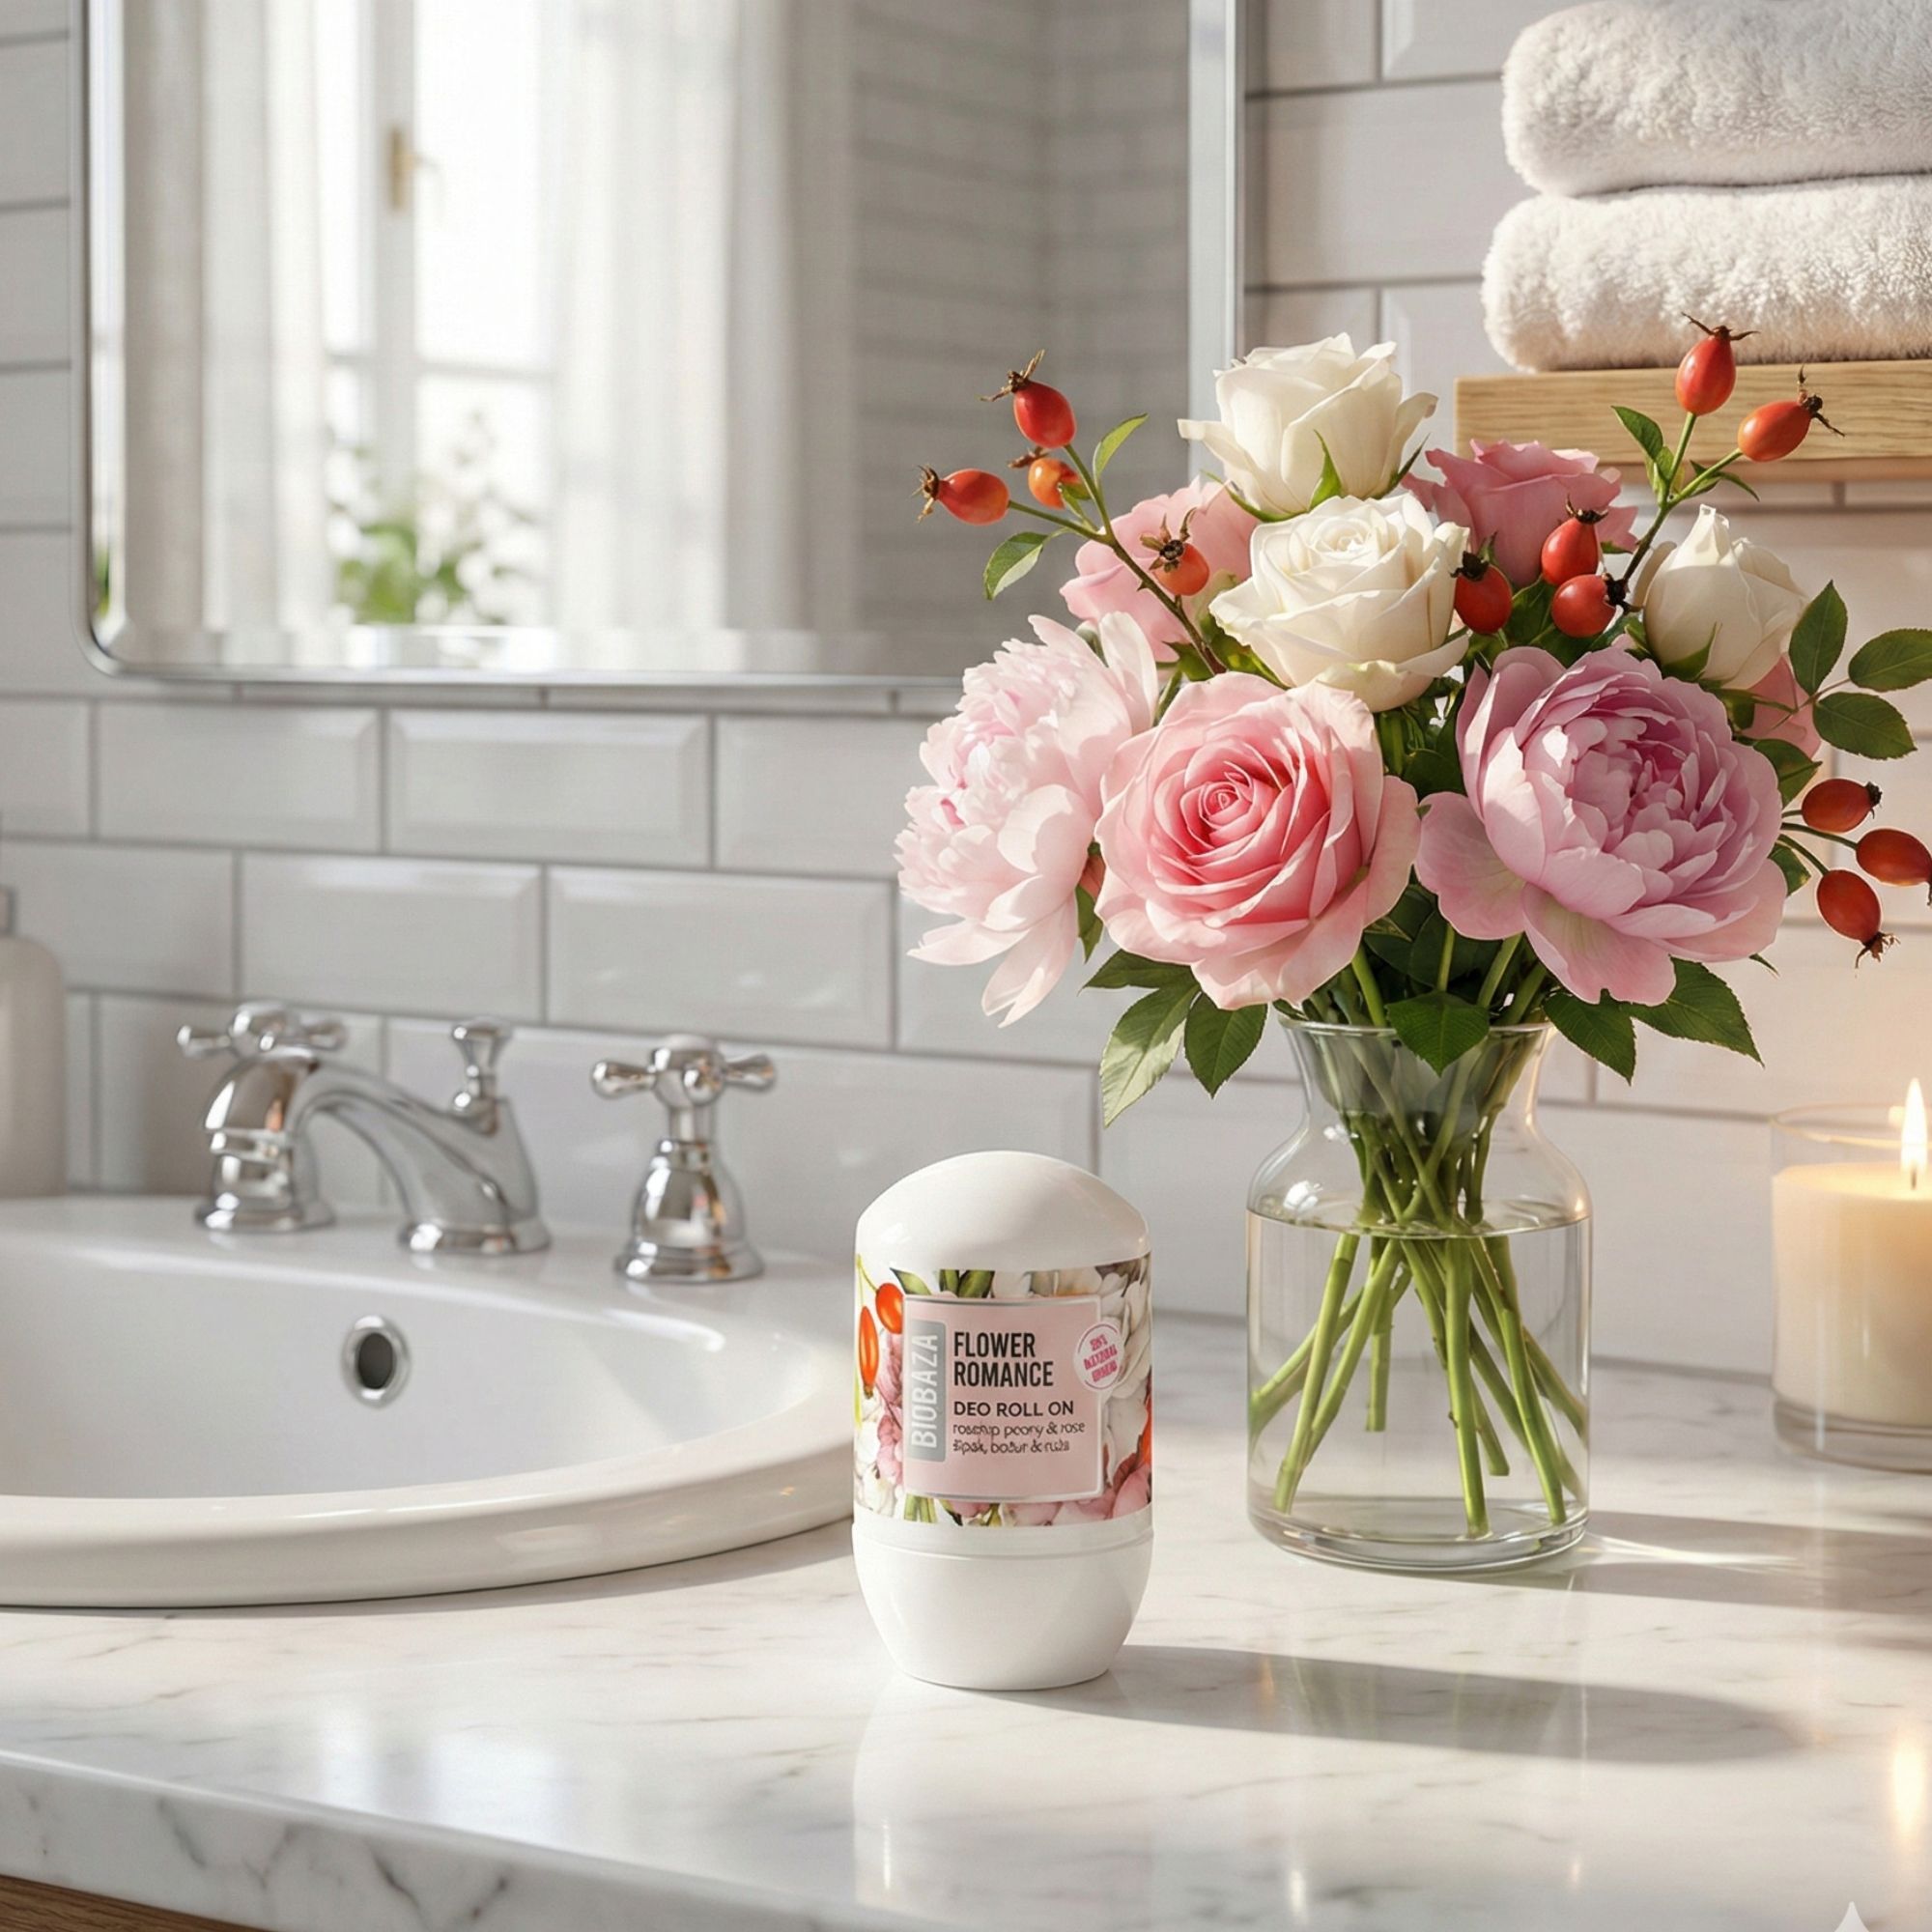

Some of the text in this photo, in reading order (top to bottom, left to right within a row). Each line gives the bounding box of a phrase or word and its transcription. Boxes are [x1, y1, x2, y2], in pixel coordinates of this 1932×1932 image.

[954, 1331, 1036, 1358] FLOWER
[954, 1360, 1054, 1387] ROMANCE
[911, 1335, 938, 1448] BIOBAZA
[954, 1401, 1074, 1417] DEO ROLL ON
[1046, 1421, 1058, 1435] &
[1061, 1421, 1085, 1434] rose
